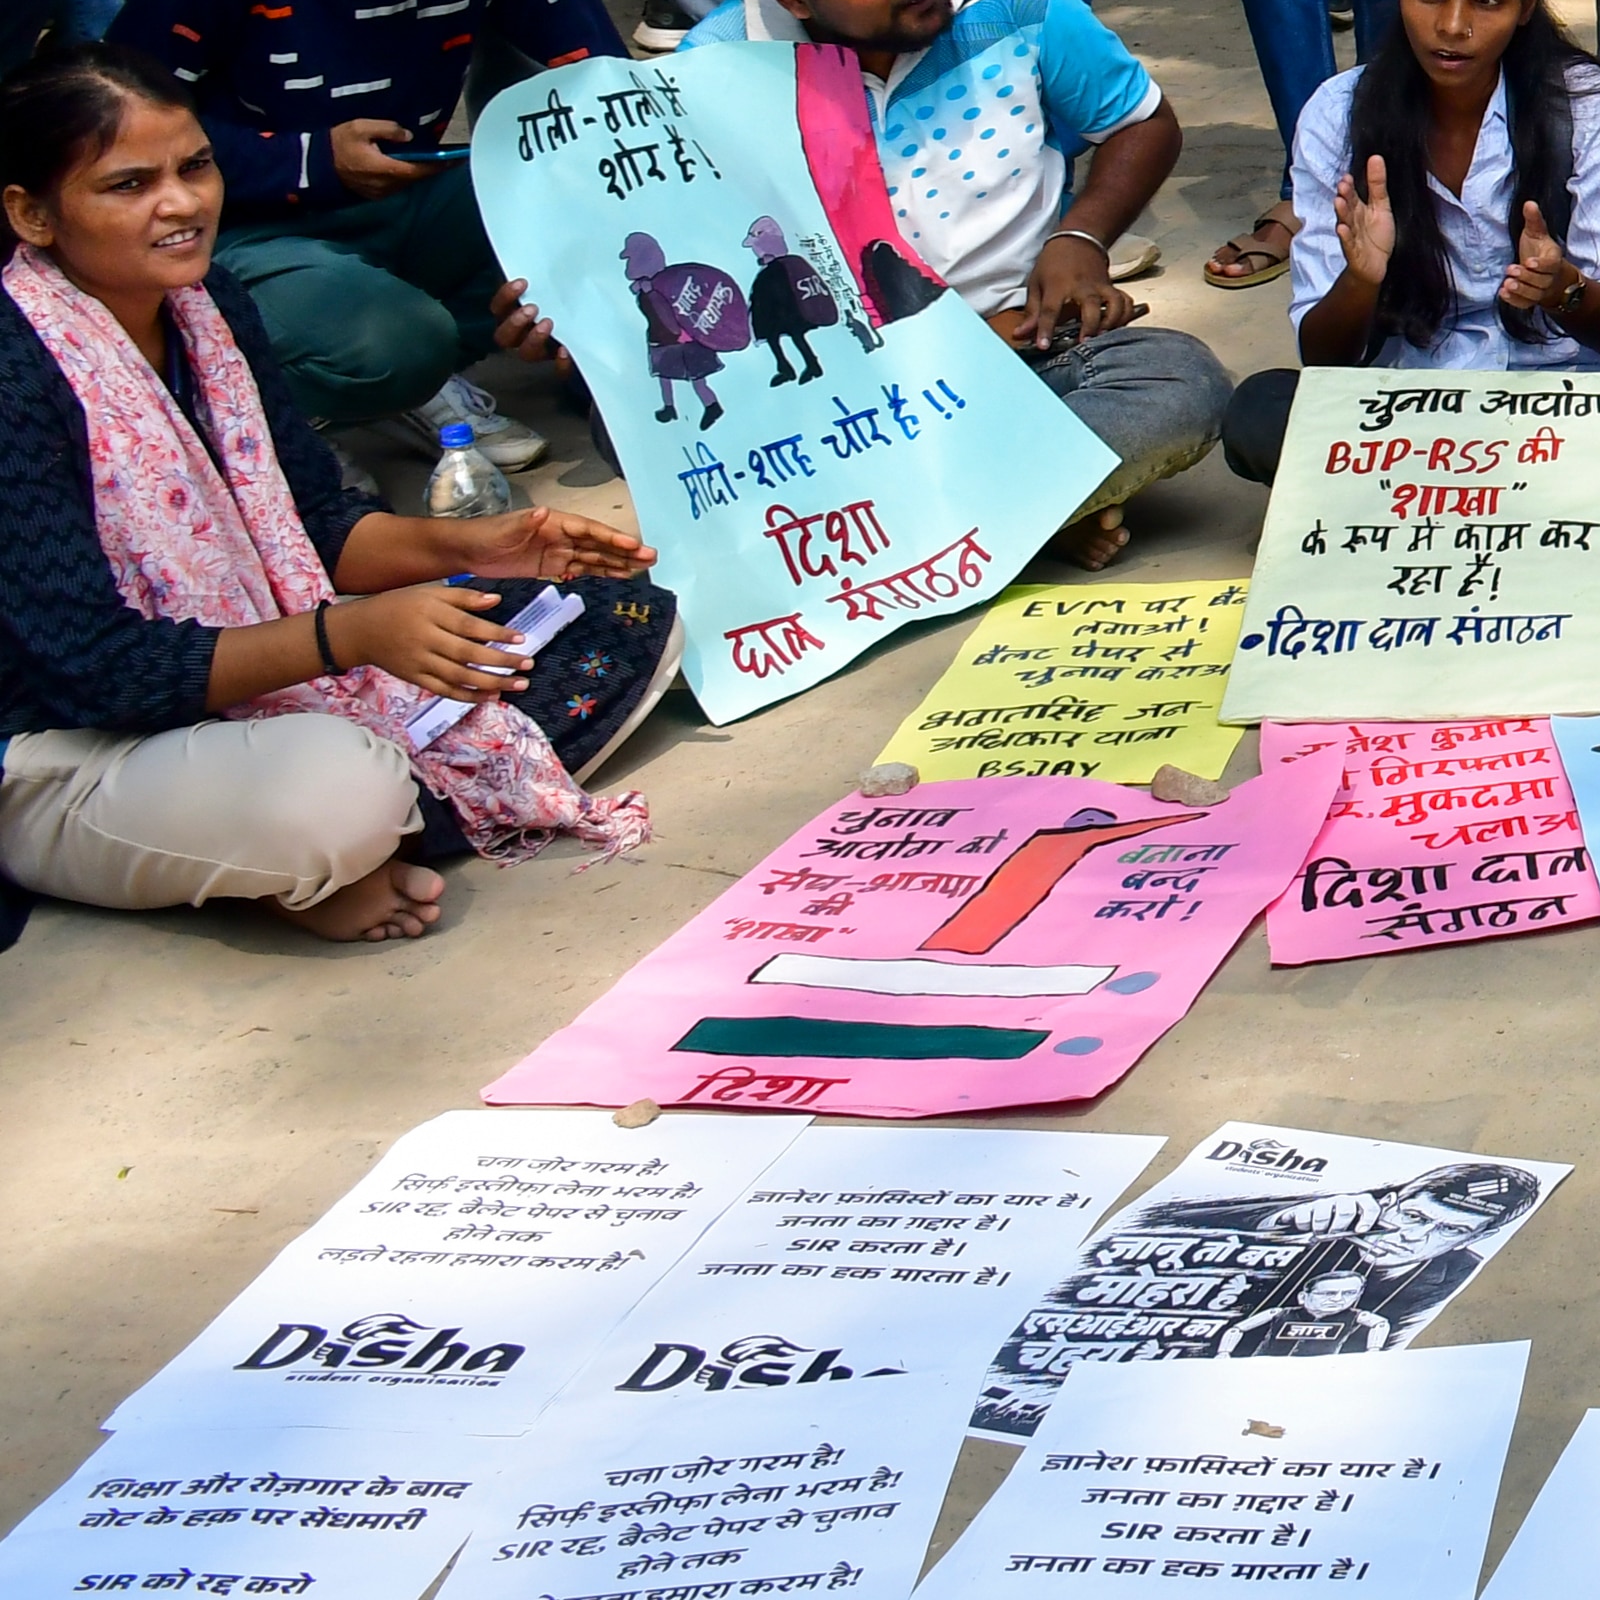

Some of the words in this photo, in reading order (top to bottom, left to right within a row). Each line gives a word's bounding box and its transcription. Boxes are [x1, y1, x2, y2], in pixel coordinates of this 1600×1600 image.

[599, 139, 666, 200] शोर
[670, 125, 721, 182] है!
[1359, 389, 1471, 431] चुनाव
[1325, 438, 1509, 474] BJP-RSS
[1518, 427, 1565, 464] की
[763, 500, 890, 586] दिशा
[1023, 600, 1125, 617] EVM
[978, 761, 1100, 778] BSJAY
[678, 1067, 851, 1105] दिशा
[1205, 1137, 1330, 1174] Disha
[233, 1313, 527, 1374] Disha
[89, 1479, 180, 1498] शिक्षा
[181, 1472, 245, 1494] और
[250, 1472, 363, 1497] रोज़गार
[365, 1476, 405, 1496] के
[407, 1481, 472, 1498] बाद
